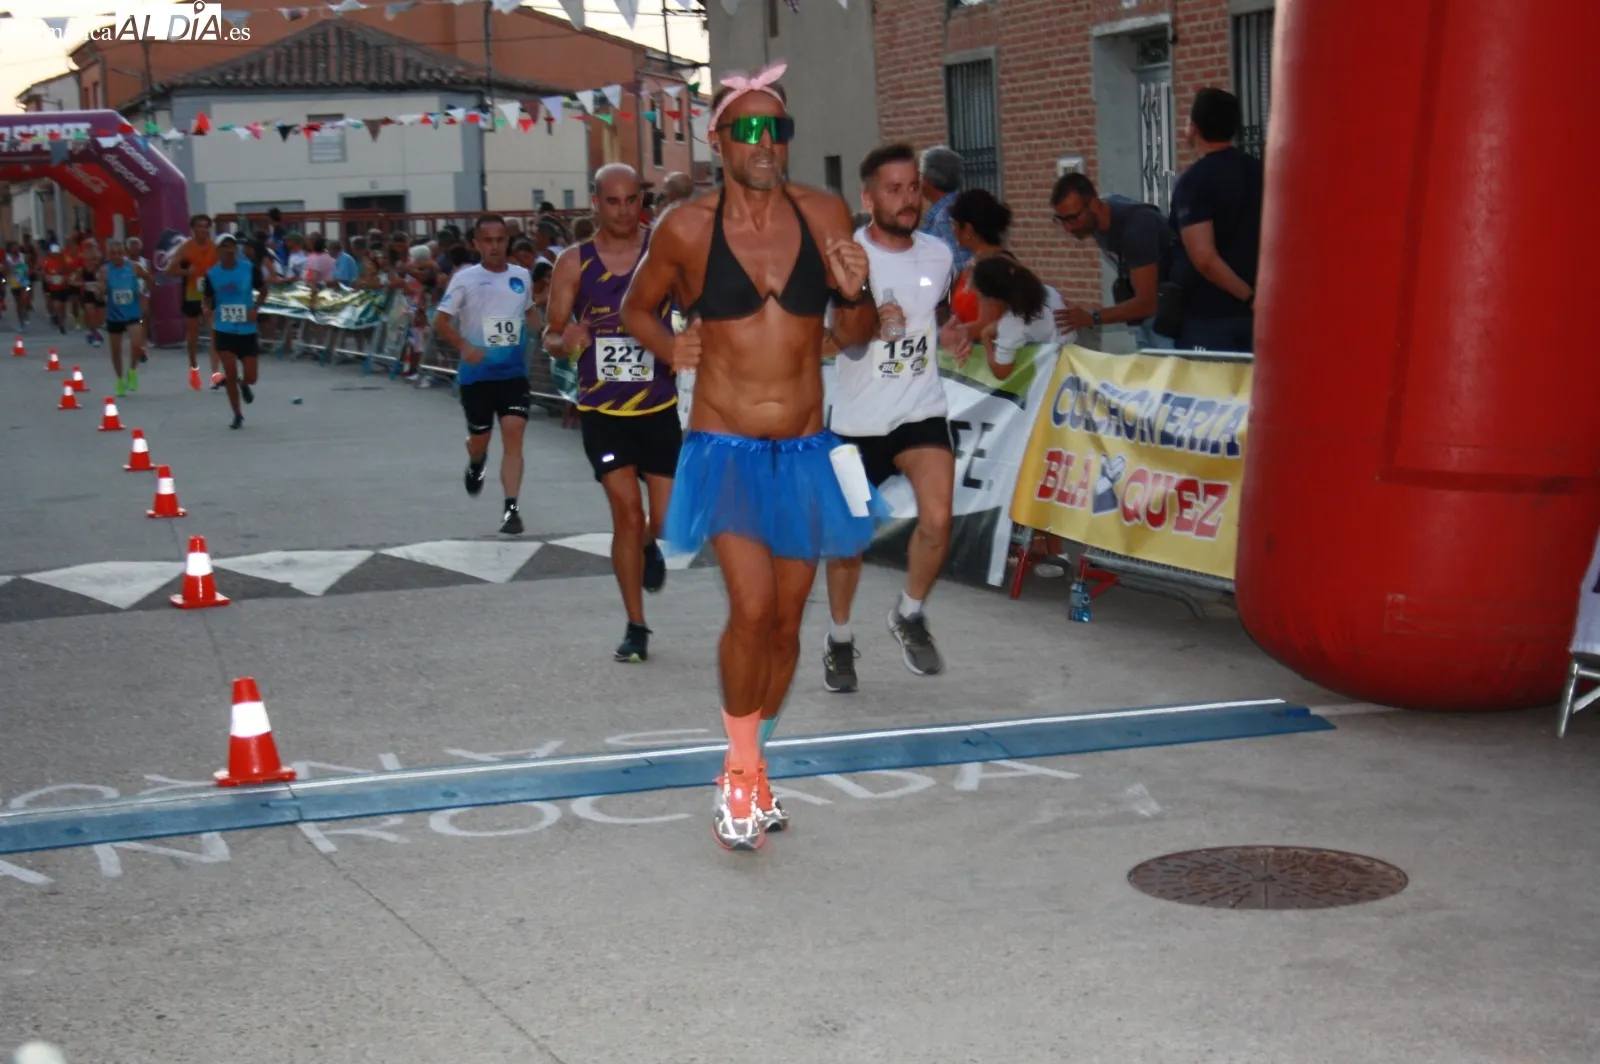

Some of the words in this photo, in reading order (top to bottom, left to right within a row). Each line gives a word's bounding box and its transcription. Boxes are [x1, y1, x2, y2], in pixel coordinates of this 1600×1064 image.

[494, 321, 514, 334] 10
[603, 345, 645, 363] 227
[883, 335, 928, 360] 154
